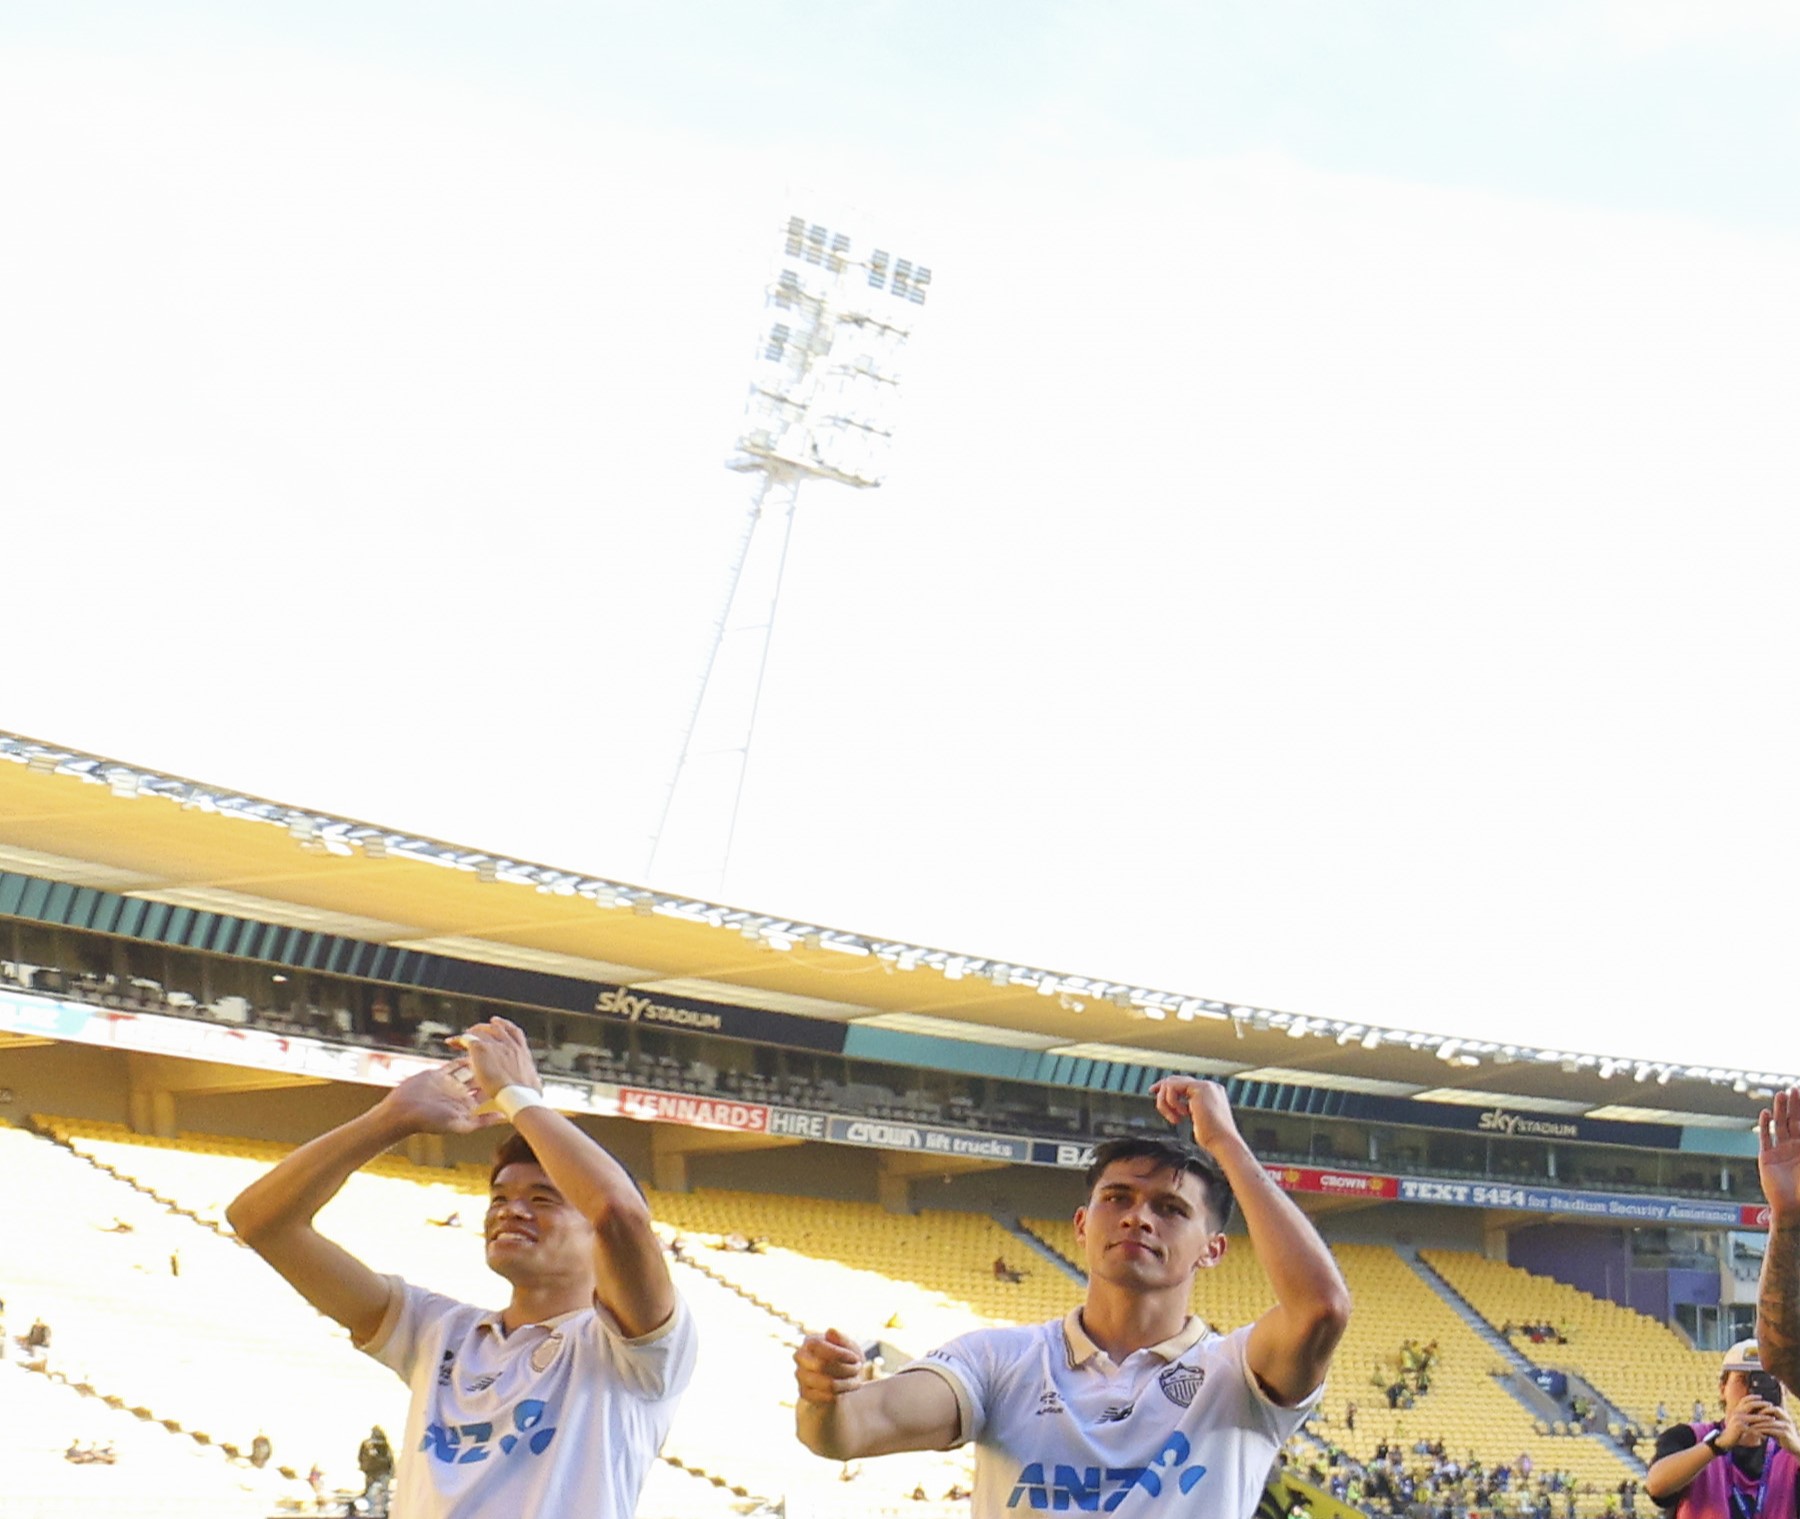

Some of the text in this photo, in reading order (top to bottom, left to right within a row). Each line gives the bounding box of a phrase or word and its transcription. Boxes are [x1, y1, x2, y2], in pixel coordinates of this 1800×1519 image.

[595, 986, 722, 1029] sky STADIUM
[621, 1091, 765, 1130] KENNARDS
[771, 1108, 826, 1136] HIRE
[1478, 1108, 1578, 1137] sky STADIUM
[926, 1132, 950, 1151] lift
[953, 1135, 1013, 1158] trucks
[1320, 1176, 1368, 1190] CROWN
[1402, 1182, 1468, 1202] TEXT
[1473, 1187, 1526, 1207] 5454
[1528, 1195, 1547, 1207] for
[1549, 1196, 1607, 1214] Stadium
[1609, 1201, 1666, 1219] Security
[1668, 1206, 1738, 1222] Assistance
[1006, 1462, 1152, 1512] ANZ
